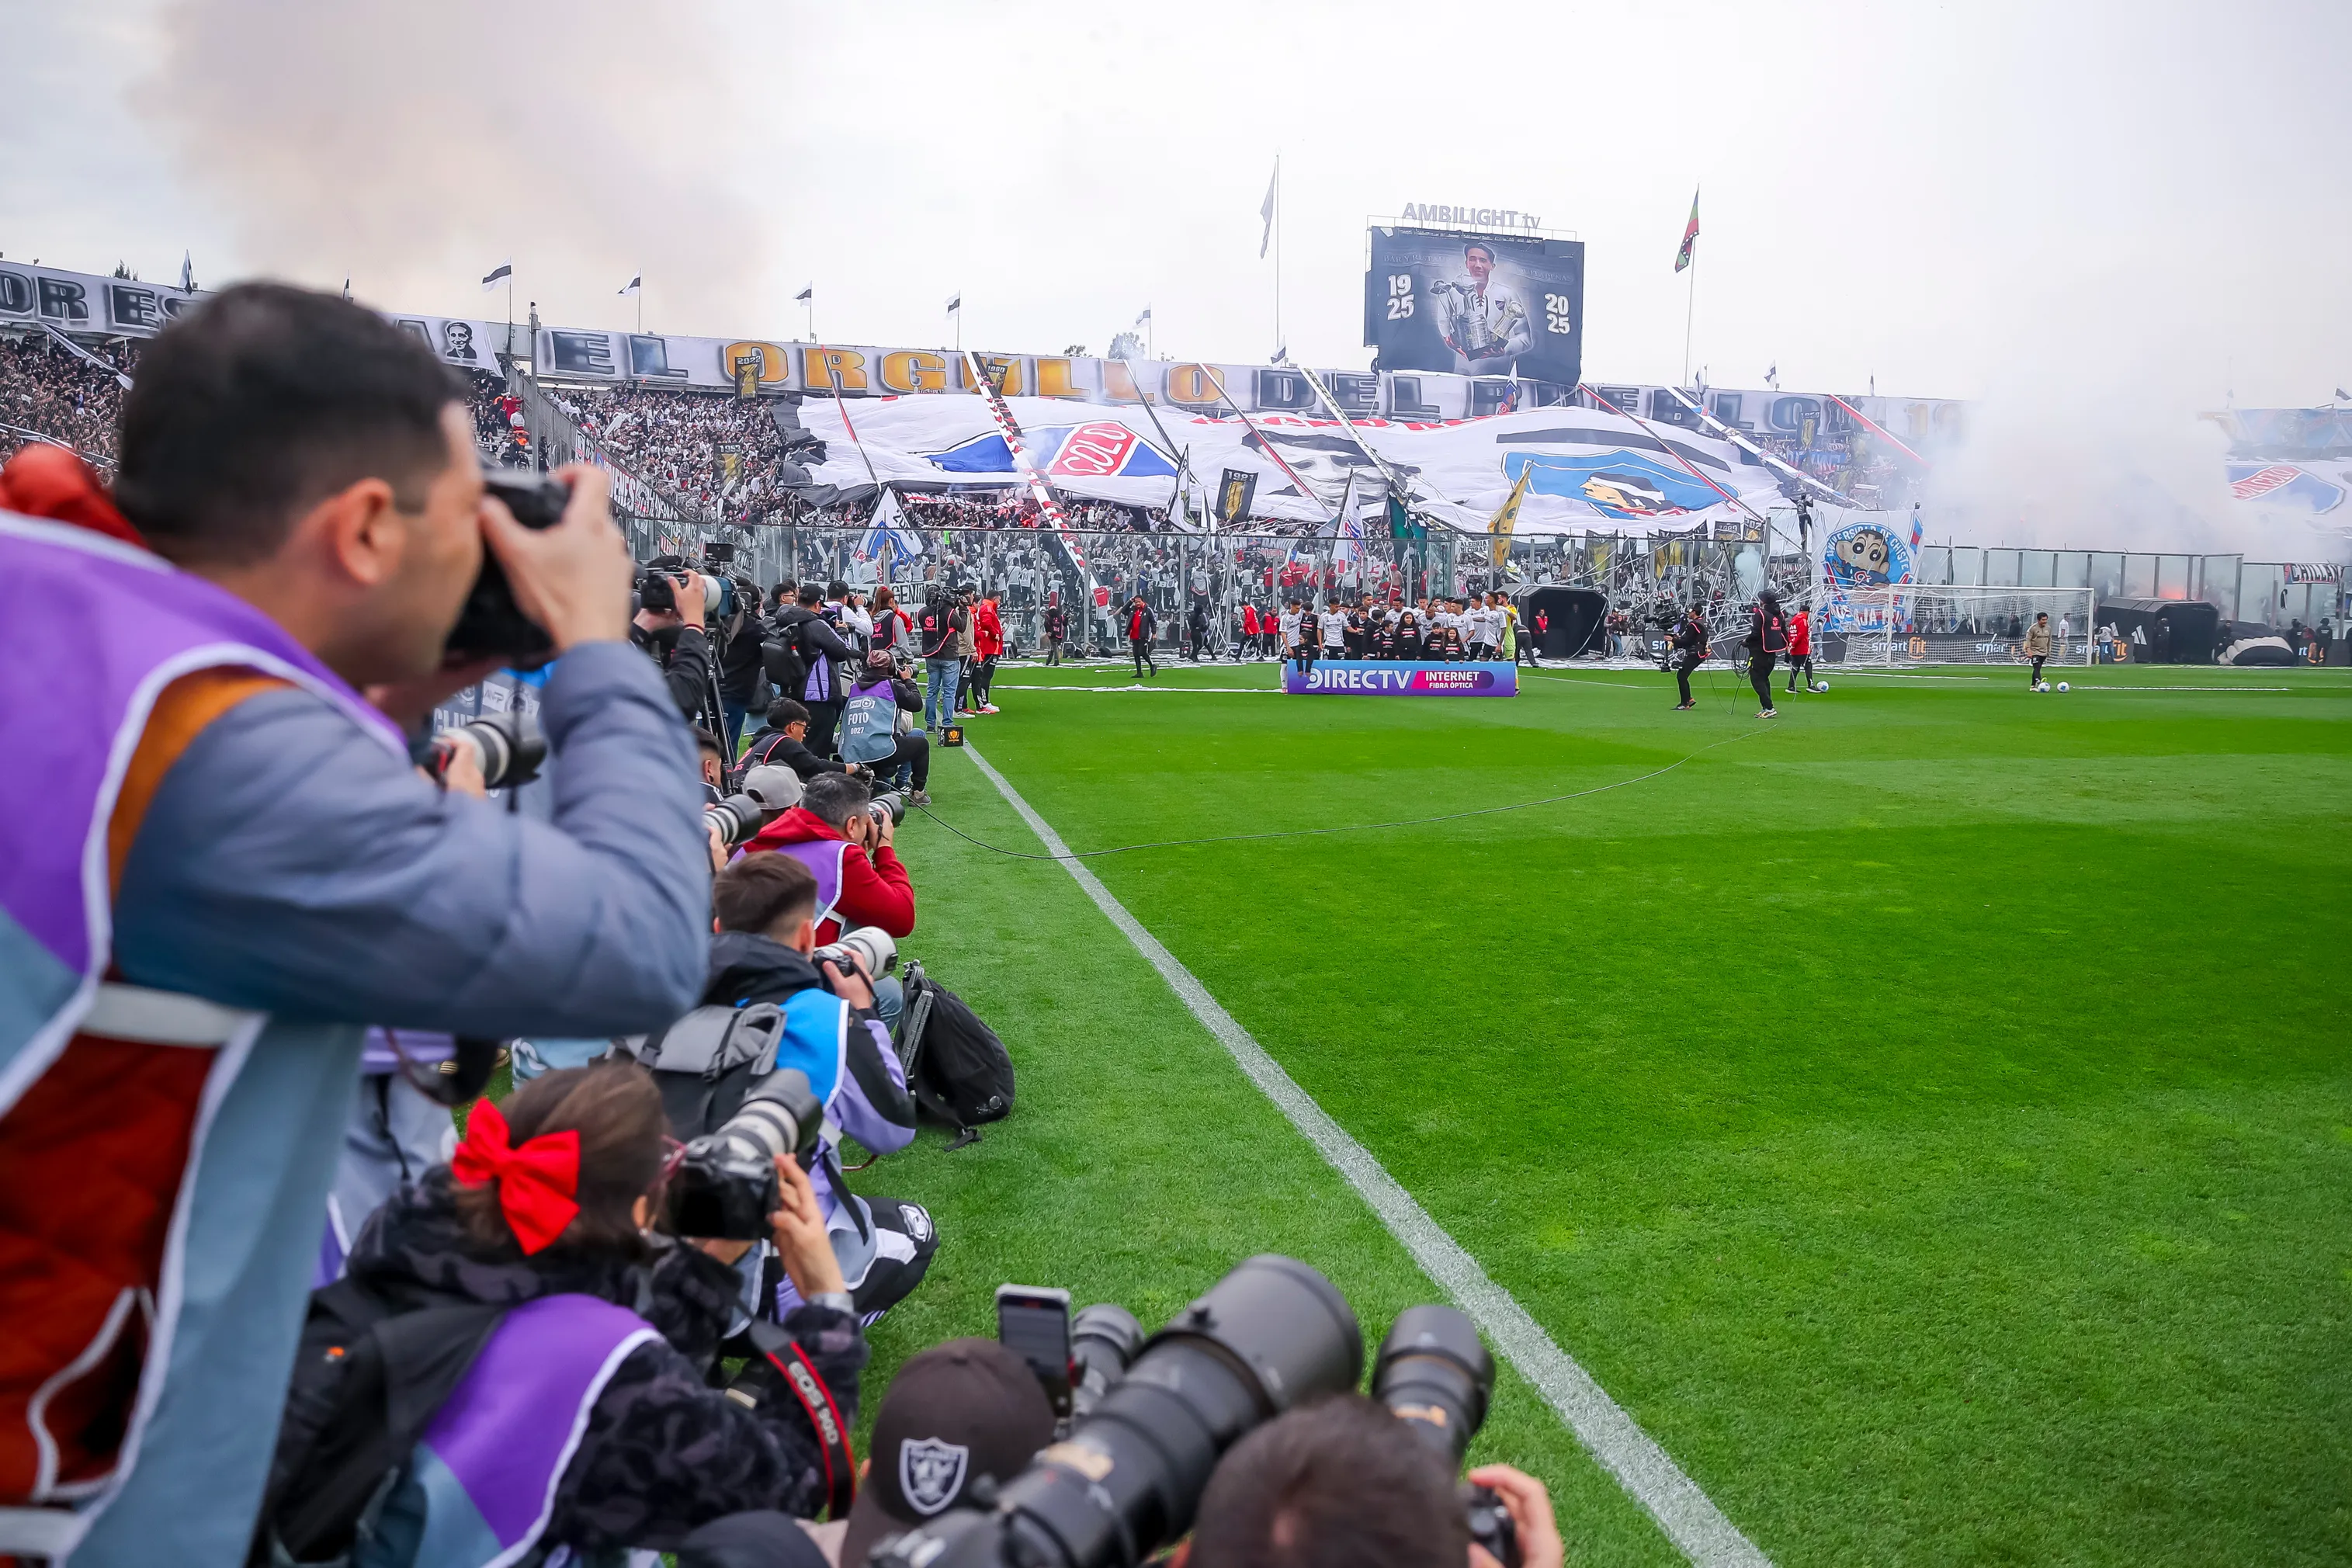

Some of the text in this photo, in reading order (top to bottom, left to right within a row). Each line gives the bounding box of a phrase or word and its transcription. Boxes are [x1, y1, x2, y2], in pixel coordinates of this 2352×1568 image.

[1402, 202, 1541, 229] AMBILIGHT tv
[1387, 274, 1413, 297] 19
[1386, 294, 1415, 321] 25
[1544, 293, 1569, 316] 20
[1546, 313, 1571, 335] 25
[737, 356, 761, 365] 2022
[987, 366, 1006, 374] 1960
[551, 331, 689, 379] EL
[726, 342, 1225, 403] ORGULLO
[1258, 369, 1441, 414] DEL
[719, 444, 742, 453] 1953
[1061, 428, 1129, 474] COLO
[1227, 470, 1254, 482] 1981
[1889, 538, 1910, 571] CHISTE
[1909, 637, 1926, 658] fit
[1306, 668, 1412, 689] DIRECTV
[1425, 671, 1480, 682] INTERNET
[1450, 680, 1473, 689] ÓPTICA
[848, 711, 869, 726] FOTO
[850, 727, 864, 735] 0027
